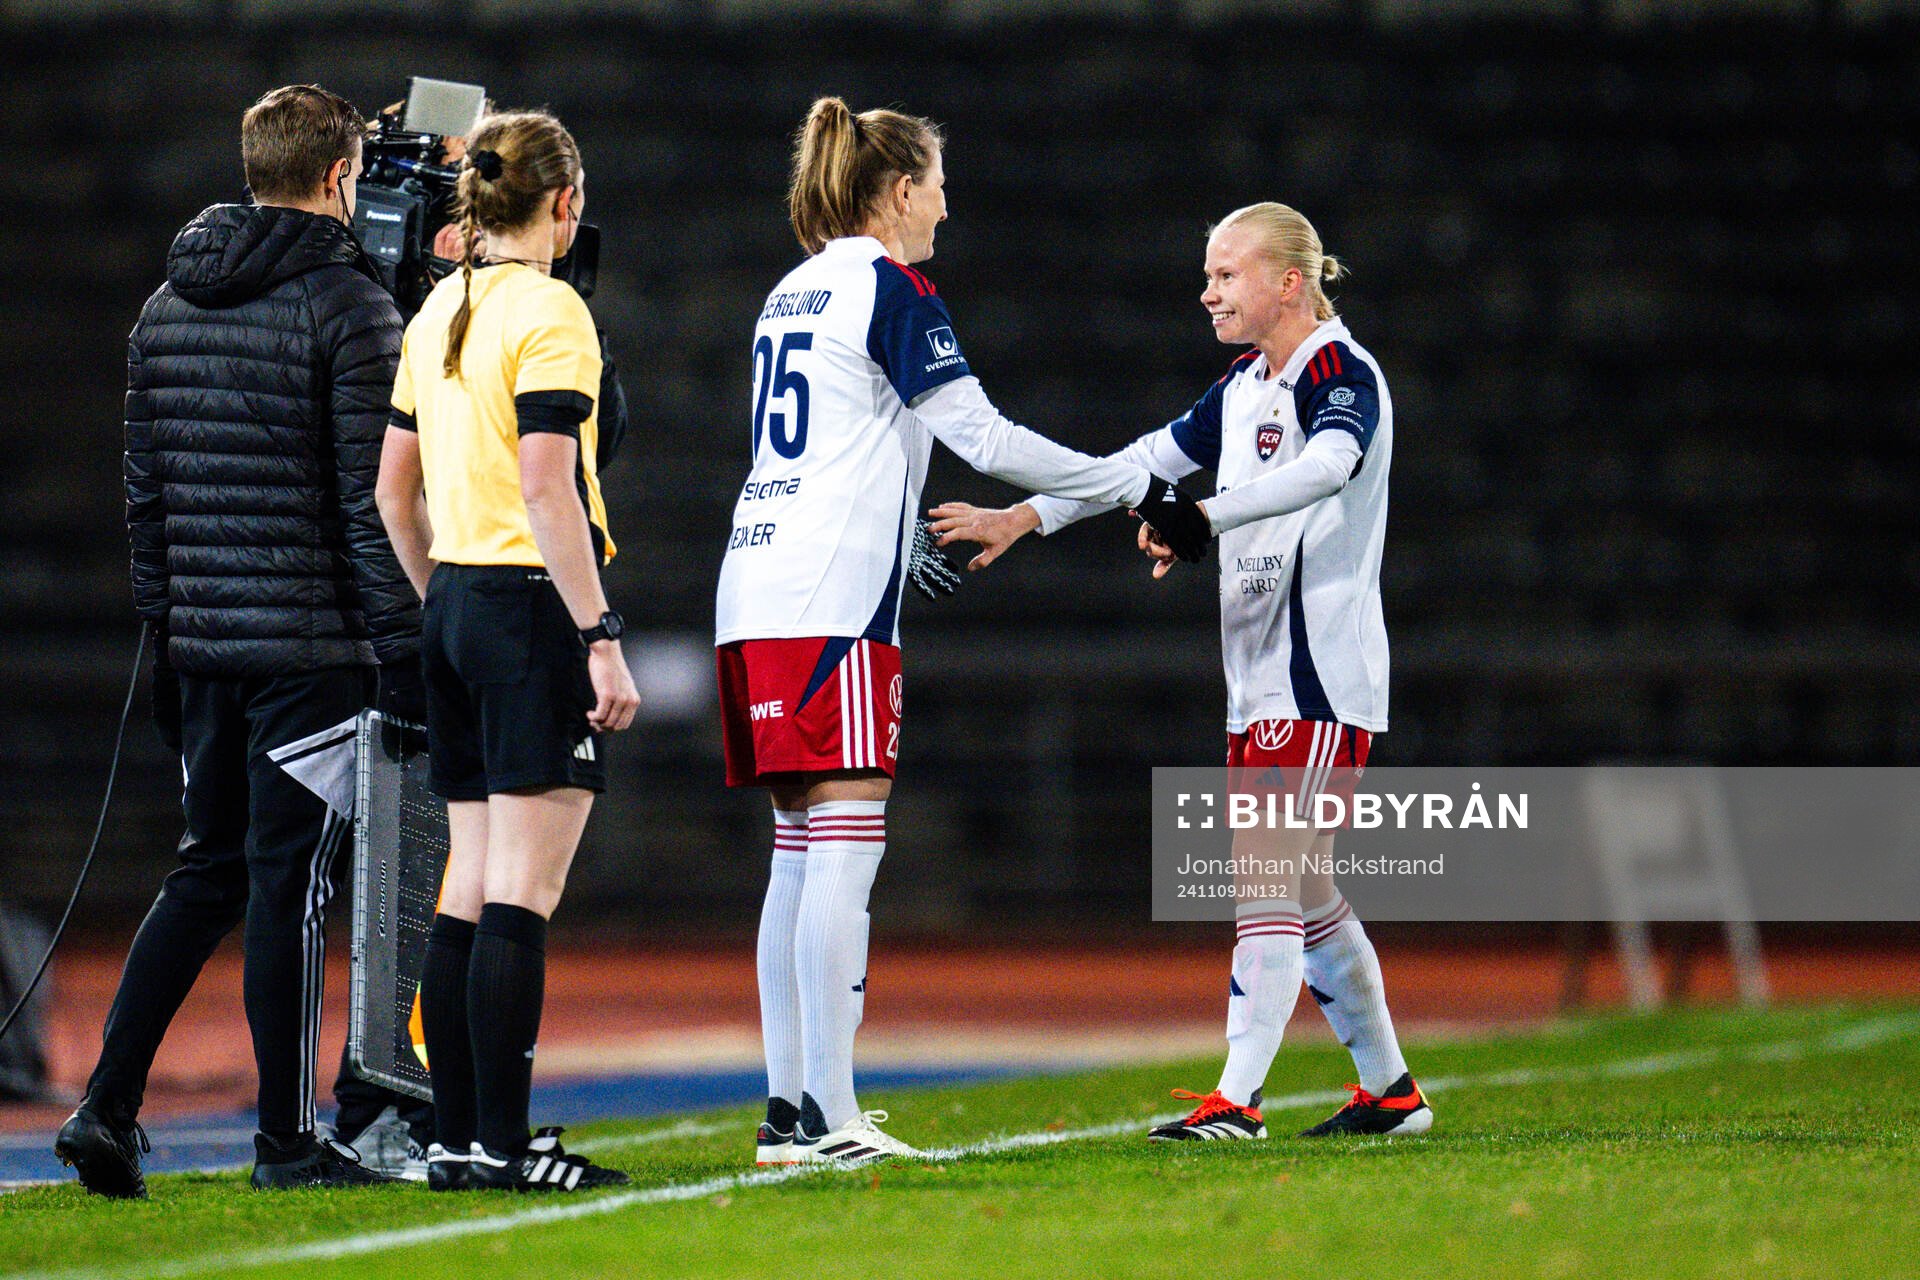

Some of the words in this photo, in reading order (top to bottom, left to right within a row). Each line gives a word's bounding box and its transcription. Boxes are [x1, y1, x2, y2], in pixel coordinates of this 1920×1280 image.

[925, 356, 959, 373] SVENSKA
[1259, 432, 1280, 444] FCR
[730, 522, 776, 550] EXER
[1241, 575, 1278, 594] GÅRD
[886, 721, 900, 760] 2
